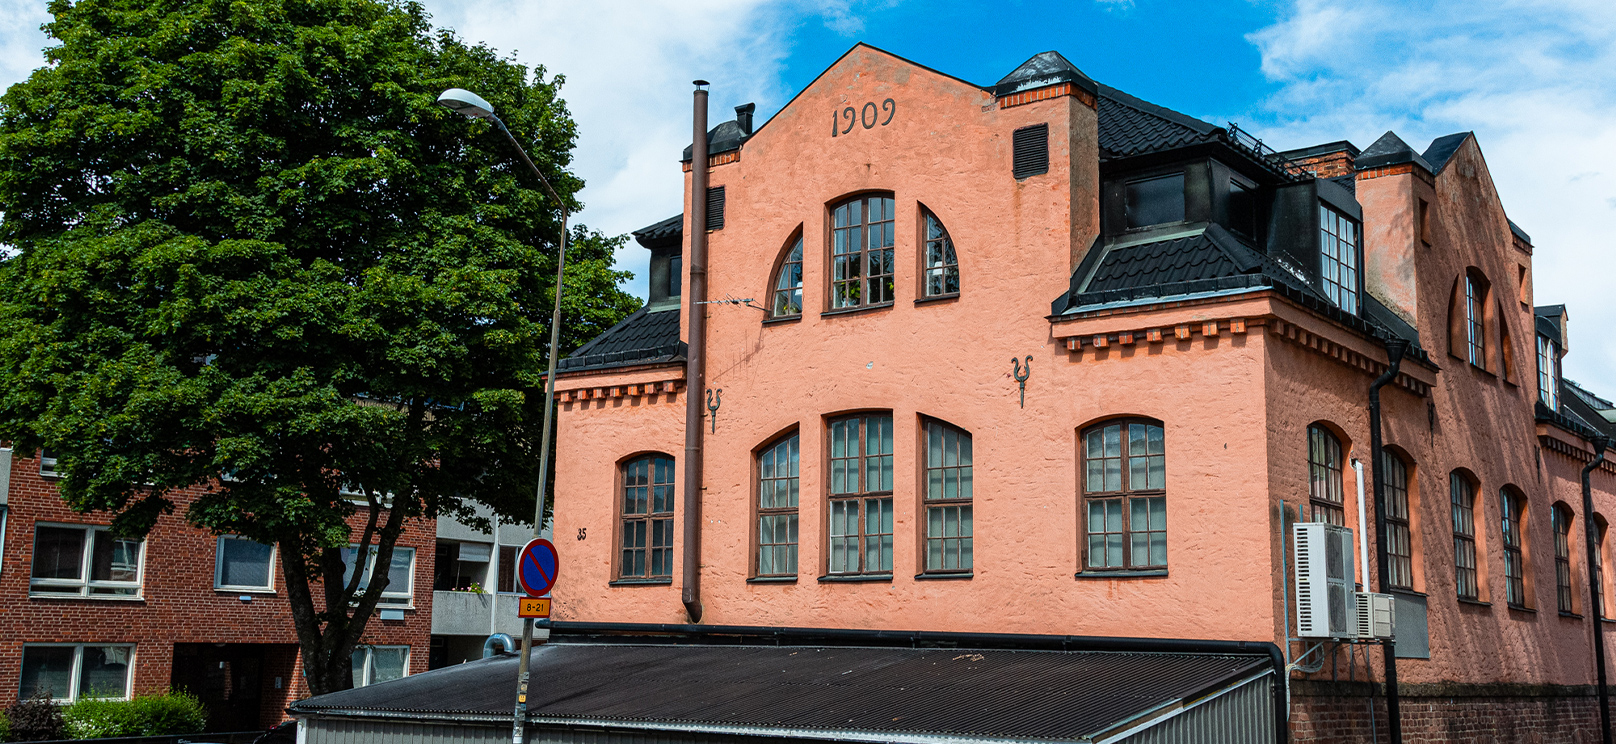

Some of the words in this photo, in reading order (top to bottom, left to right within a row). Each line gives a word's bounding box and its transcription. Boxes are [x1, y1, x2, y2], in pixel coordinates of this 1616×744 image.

[832, 98, 896, 138] 1909
[577, 527, 587, 541] 35
[526, 603, 544, 612] 8-21
